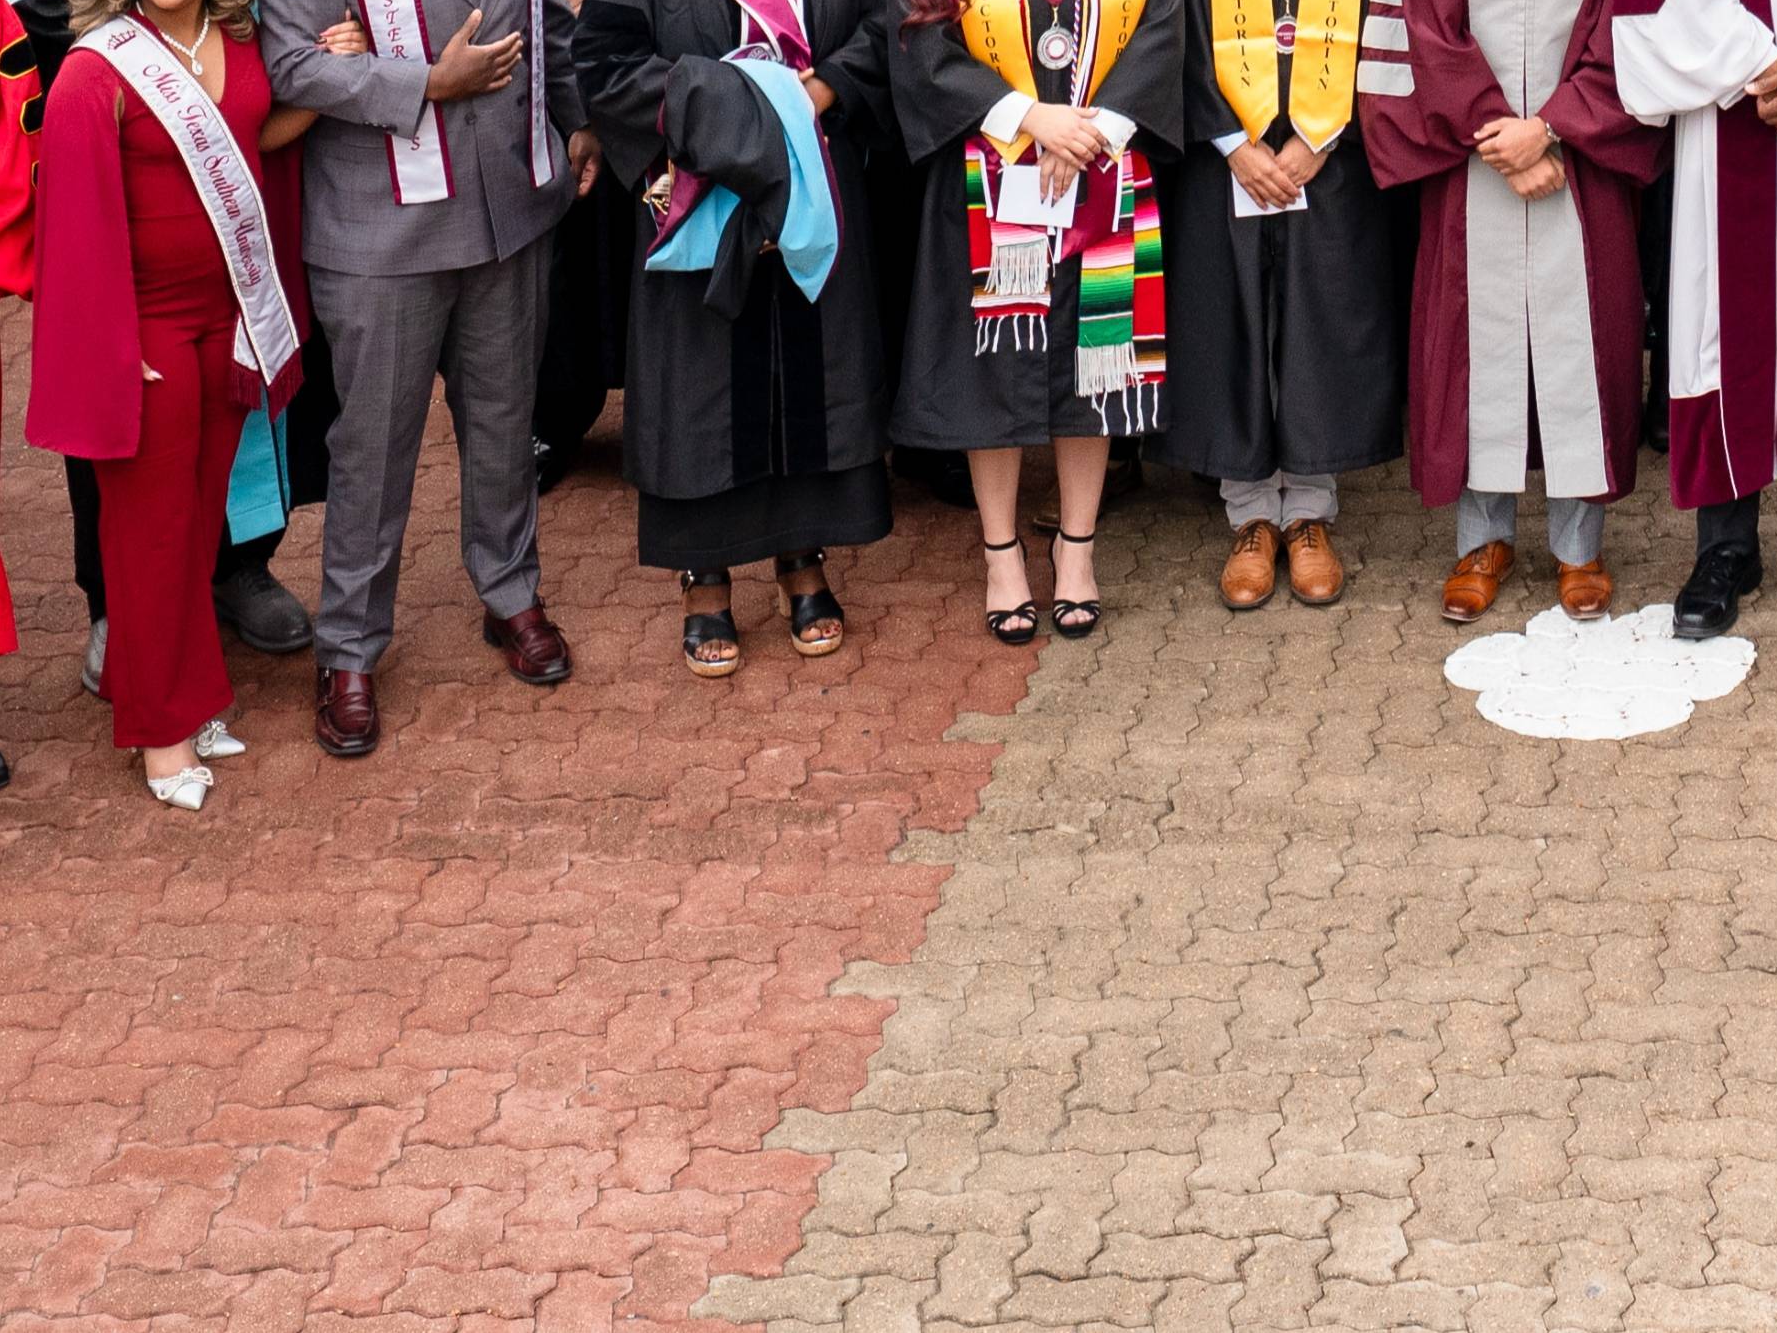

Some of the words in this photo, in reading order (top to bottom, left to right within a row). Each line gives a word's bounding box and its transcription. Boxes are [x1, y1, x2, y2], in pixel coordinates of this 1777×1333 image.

[142, 63, 181, 105] Miss
[177, 102, 209, 153] Texas
[202, 154, 240, 222] Southern
[234, 213, 262, 290] University
